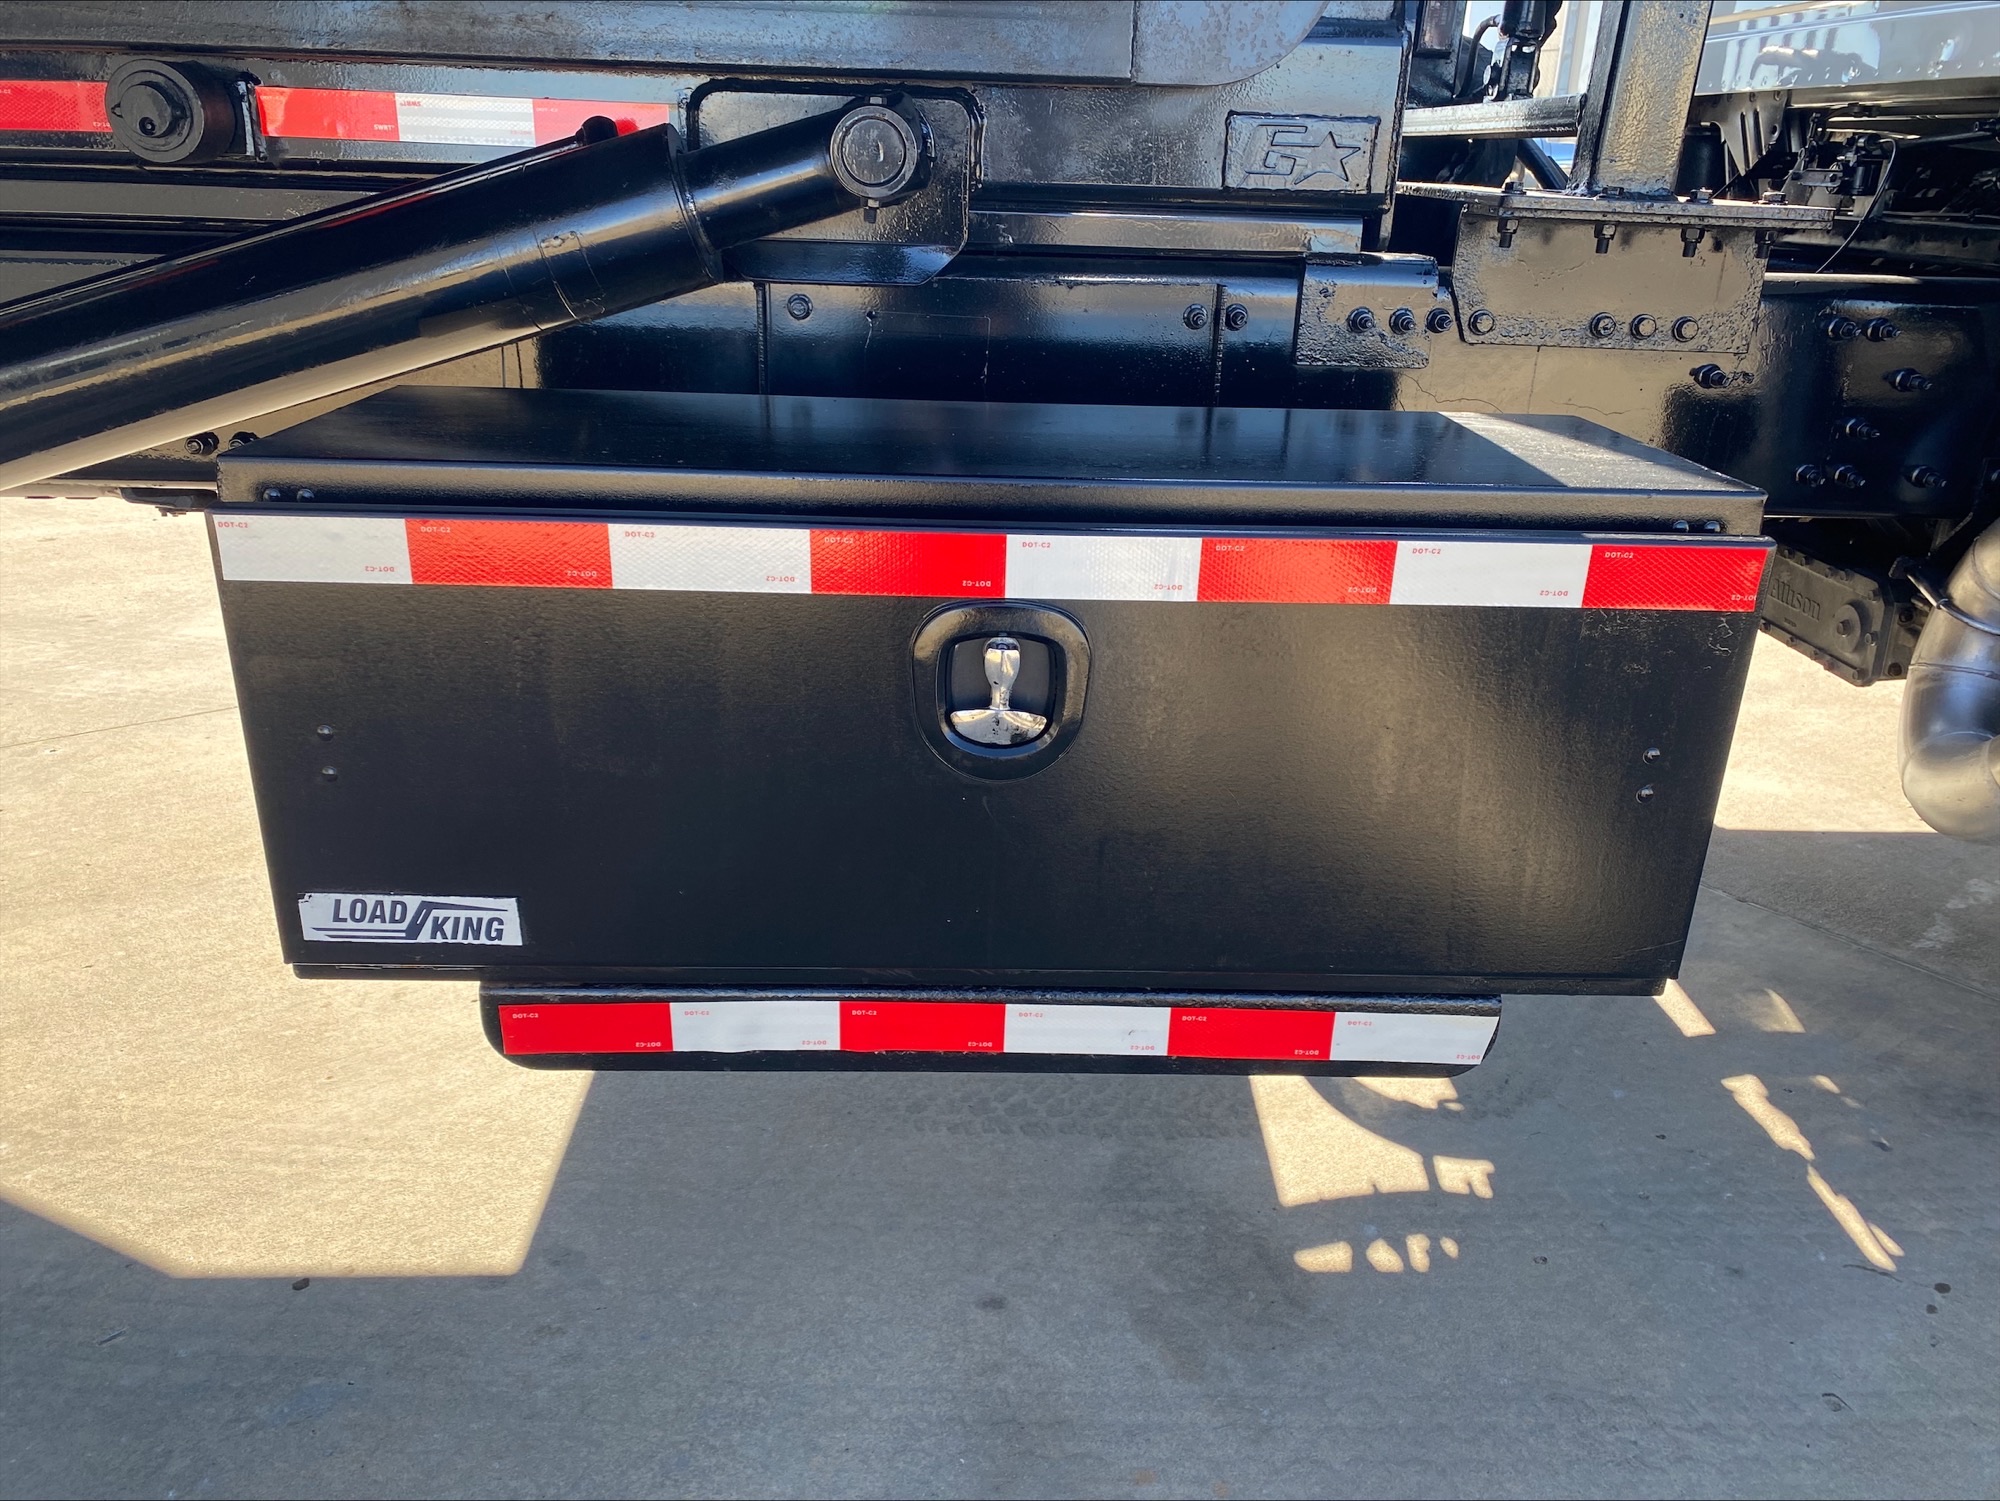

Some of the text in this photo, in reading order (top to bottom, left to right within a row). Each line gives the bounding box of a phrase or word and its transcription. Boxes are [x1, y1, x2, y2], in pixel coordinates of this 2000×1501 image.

[1770, 578, 1820, 621] Allison
[332, 898, 505, 942] LOAD KING
